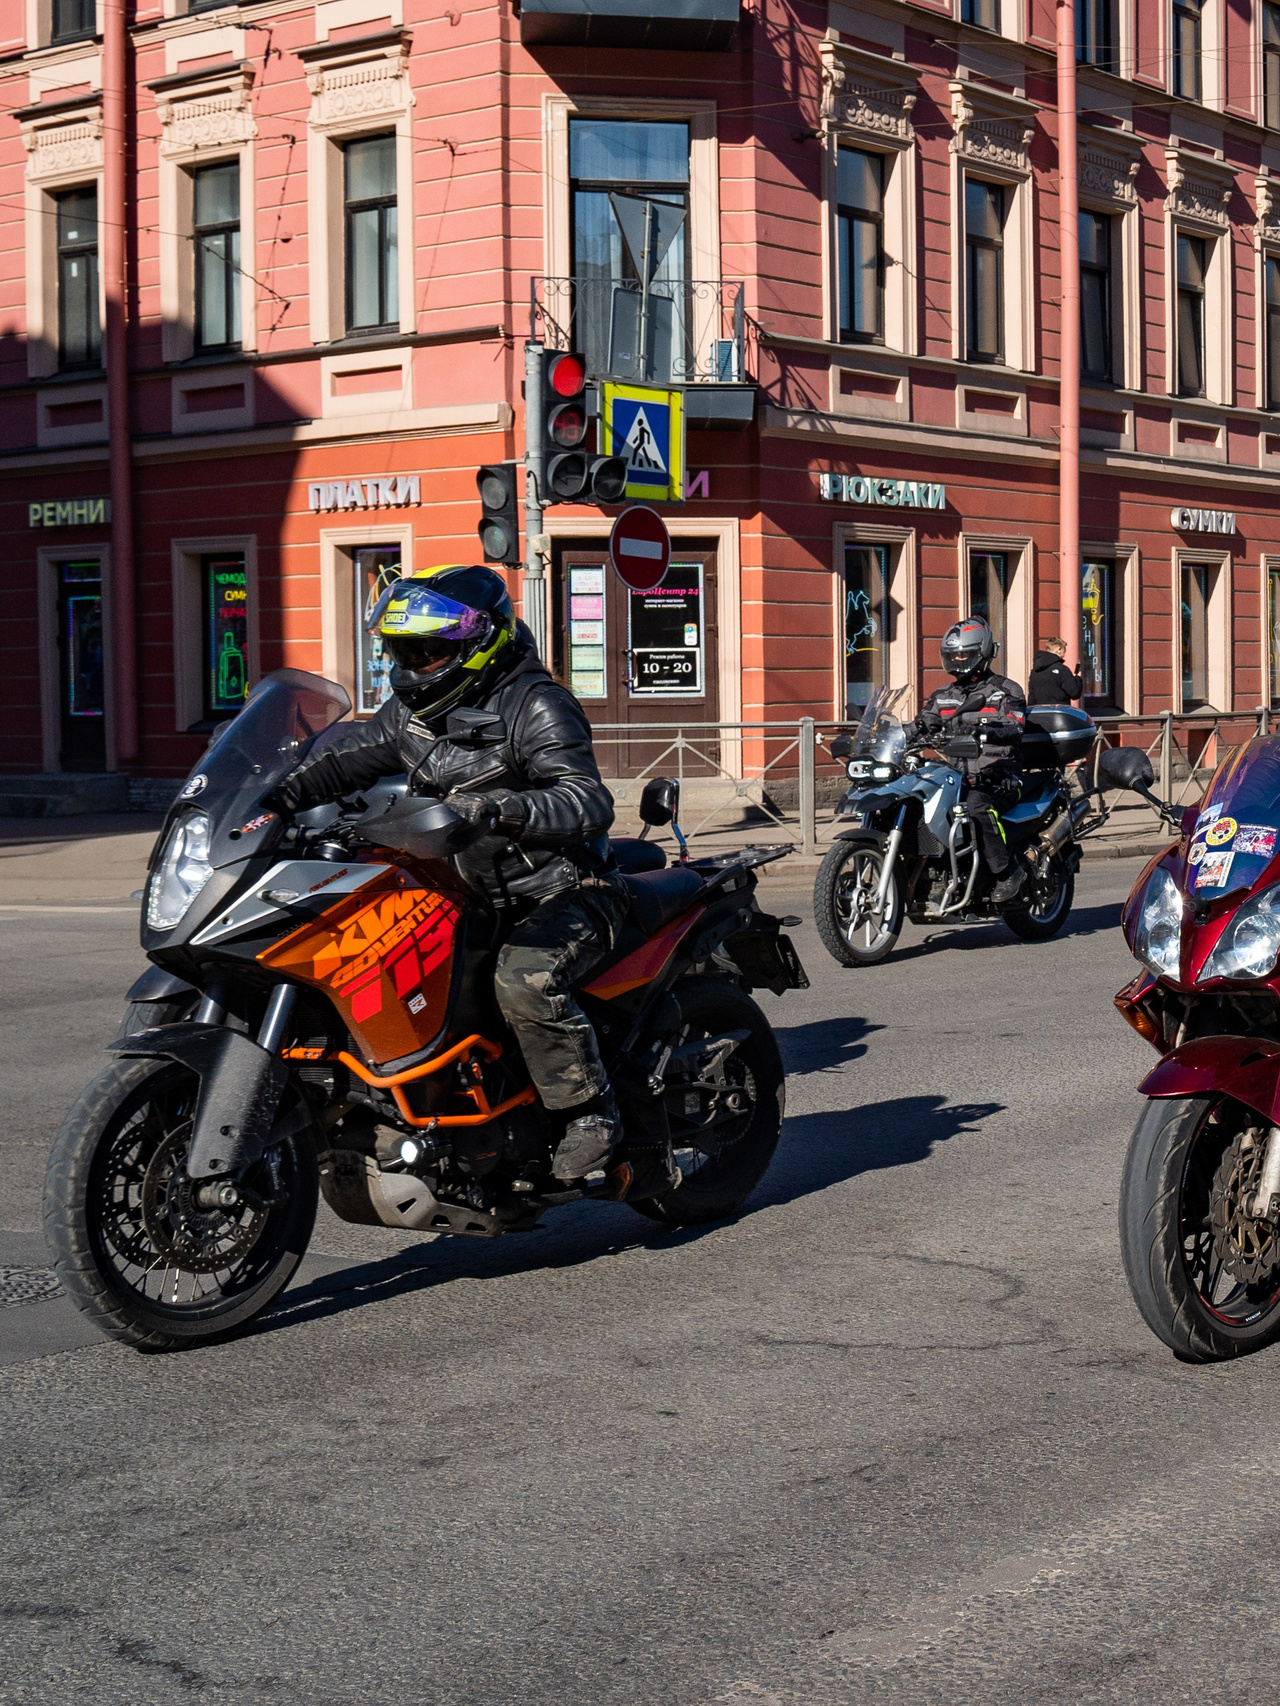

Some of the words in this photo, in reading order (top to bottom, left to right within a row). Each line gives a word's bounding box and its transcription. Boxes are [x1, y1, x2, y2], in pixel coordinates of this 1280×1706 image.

[308, 476, 421, 510] ПЛАТКИ
[820, 474, 946, 510] РЮКЗАКИ
[29, 499, 105, 527] РЕМНИ
[1171, 507, 1236, 535] СУМКИ
[643, 663, 660, 673] 10
[673, 662, 692, 673] 20
[312, 889, 429, 981] KTM
